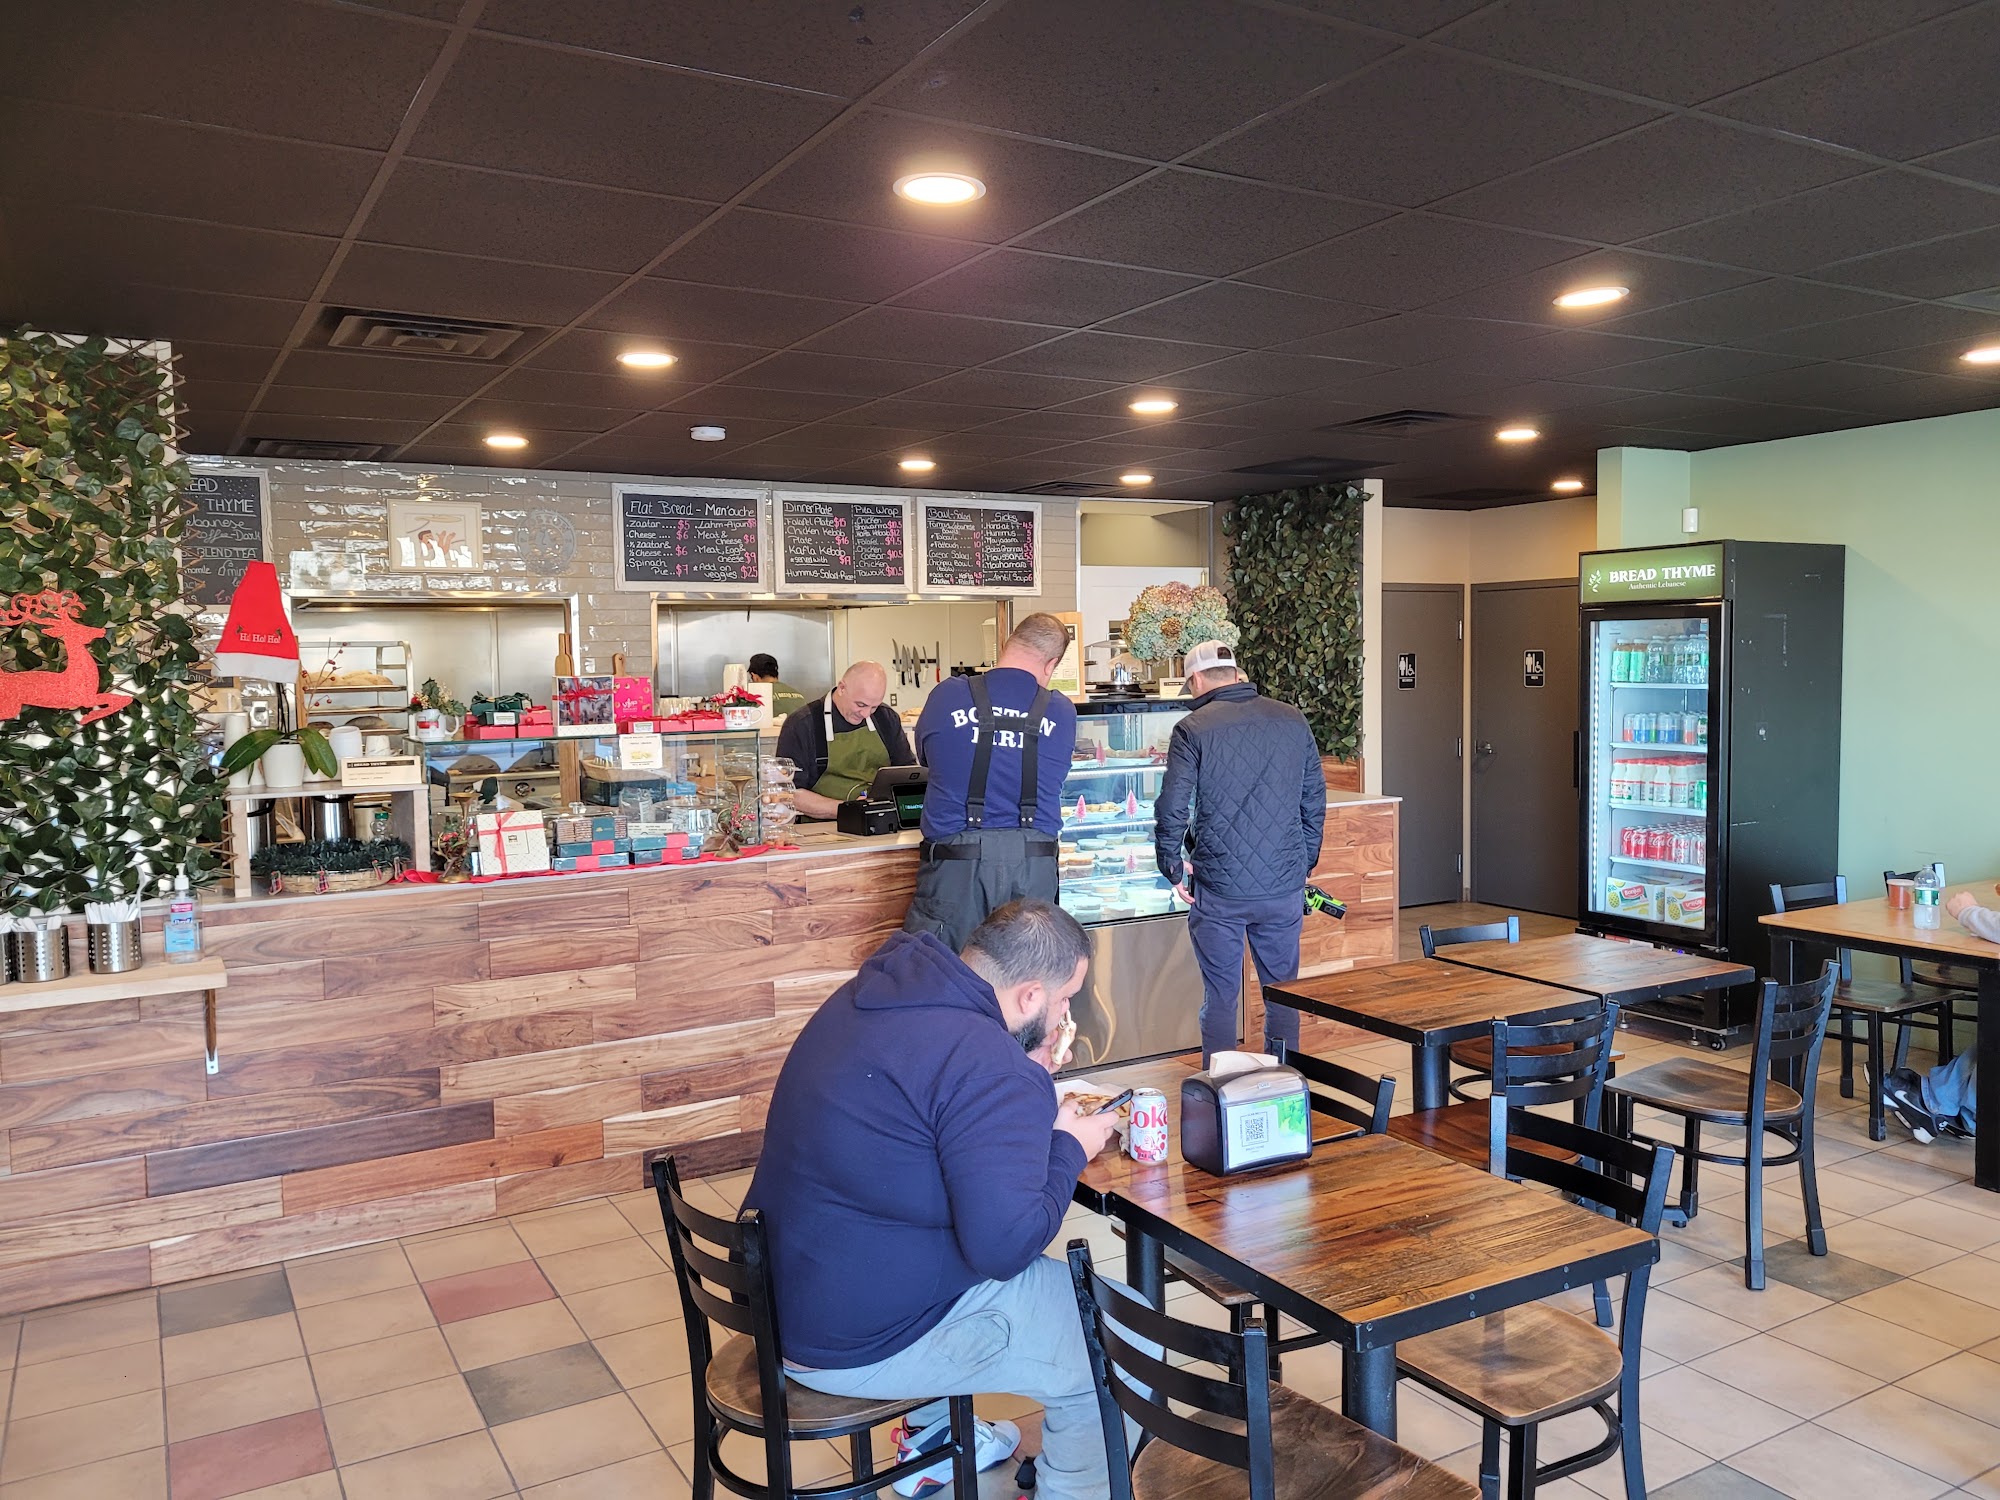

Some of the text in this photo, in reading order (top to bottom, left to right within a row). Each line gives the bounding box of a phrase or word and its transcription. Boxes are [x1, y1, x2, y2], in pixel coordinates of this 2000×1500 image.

[185, 478, 218, 492] EAD
[205, 499, 254, 513] THYME
[630, 501, 653, 514] Flat
[658, 501, 693, 515] Bread
[705, 503, 755, 517] Man'ouche
[876, 507, 898, 518] Wrap
[994, 512, 1018, 522] Sides
[186, 514, 252, 531] ebanese
[677, 520, 690, 530] $5
[629, 530, 688, 540] Cheese $6
[697, 530, 719, 540] Meat
[787, 526, 820, 536] Chicken
[743, 534, 756, 544] $8
[233, 549, 256, 558] TEA
[675, 544, 688, 556] $6
[744, 552, 756, 564] $9
[975, 552, 980, 560] 9
[629, 558, 667, 571] Spinach
[700, 562, 716, 571] Add
[651, 564, 688, 578] Pie $7
[1609, 564, 1716, 583] BREAD THYME
[1028, 574, 1032, 582] 6
